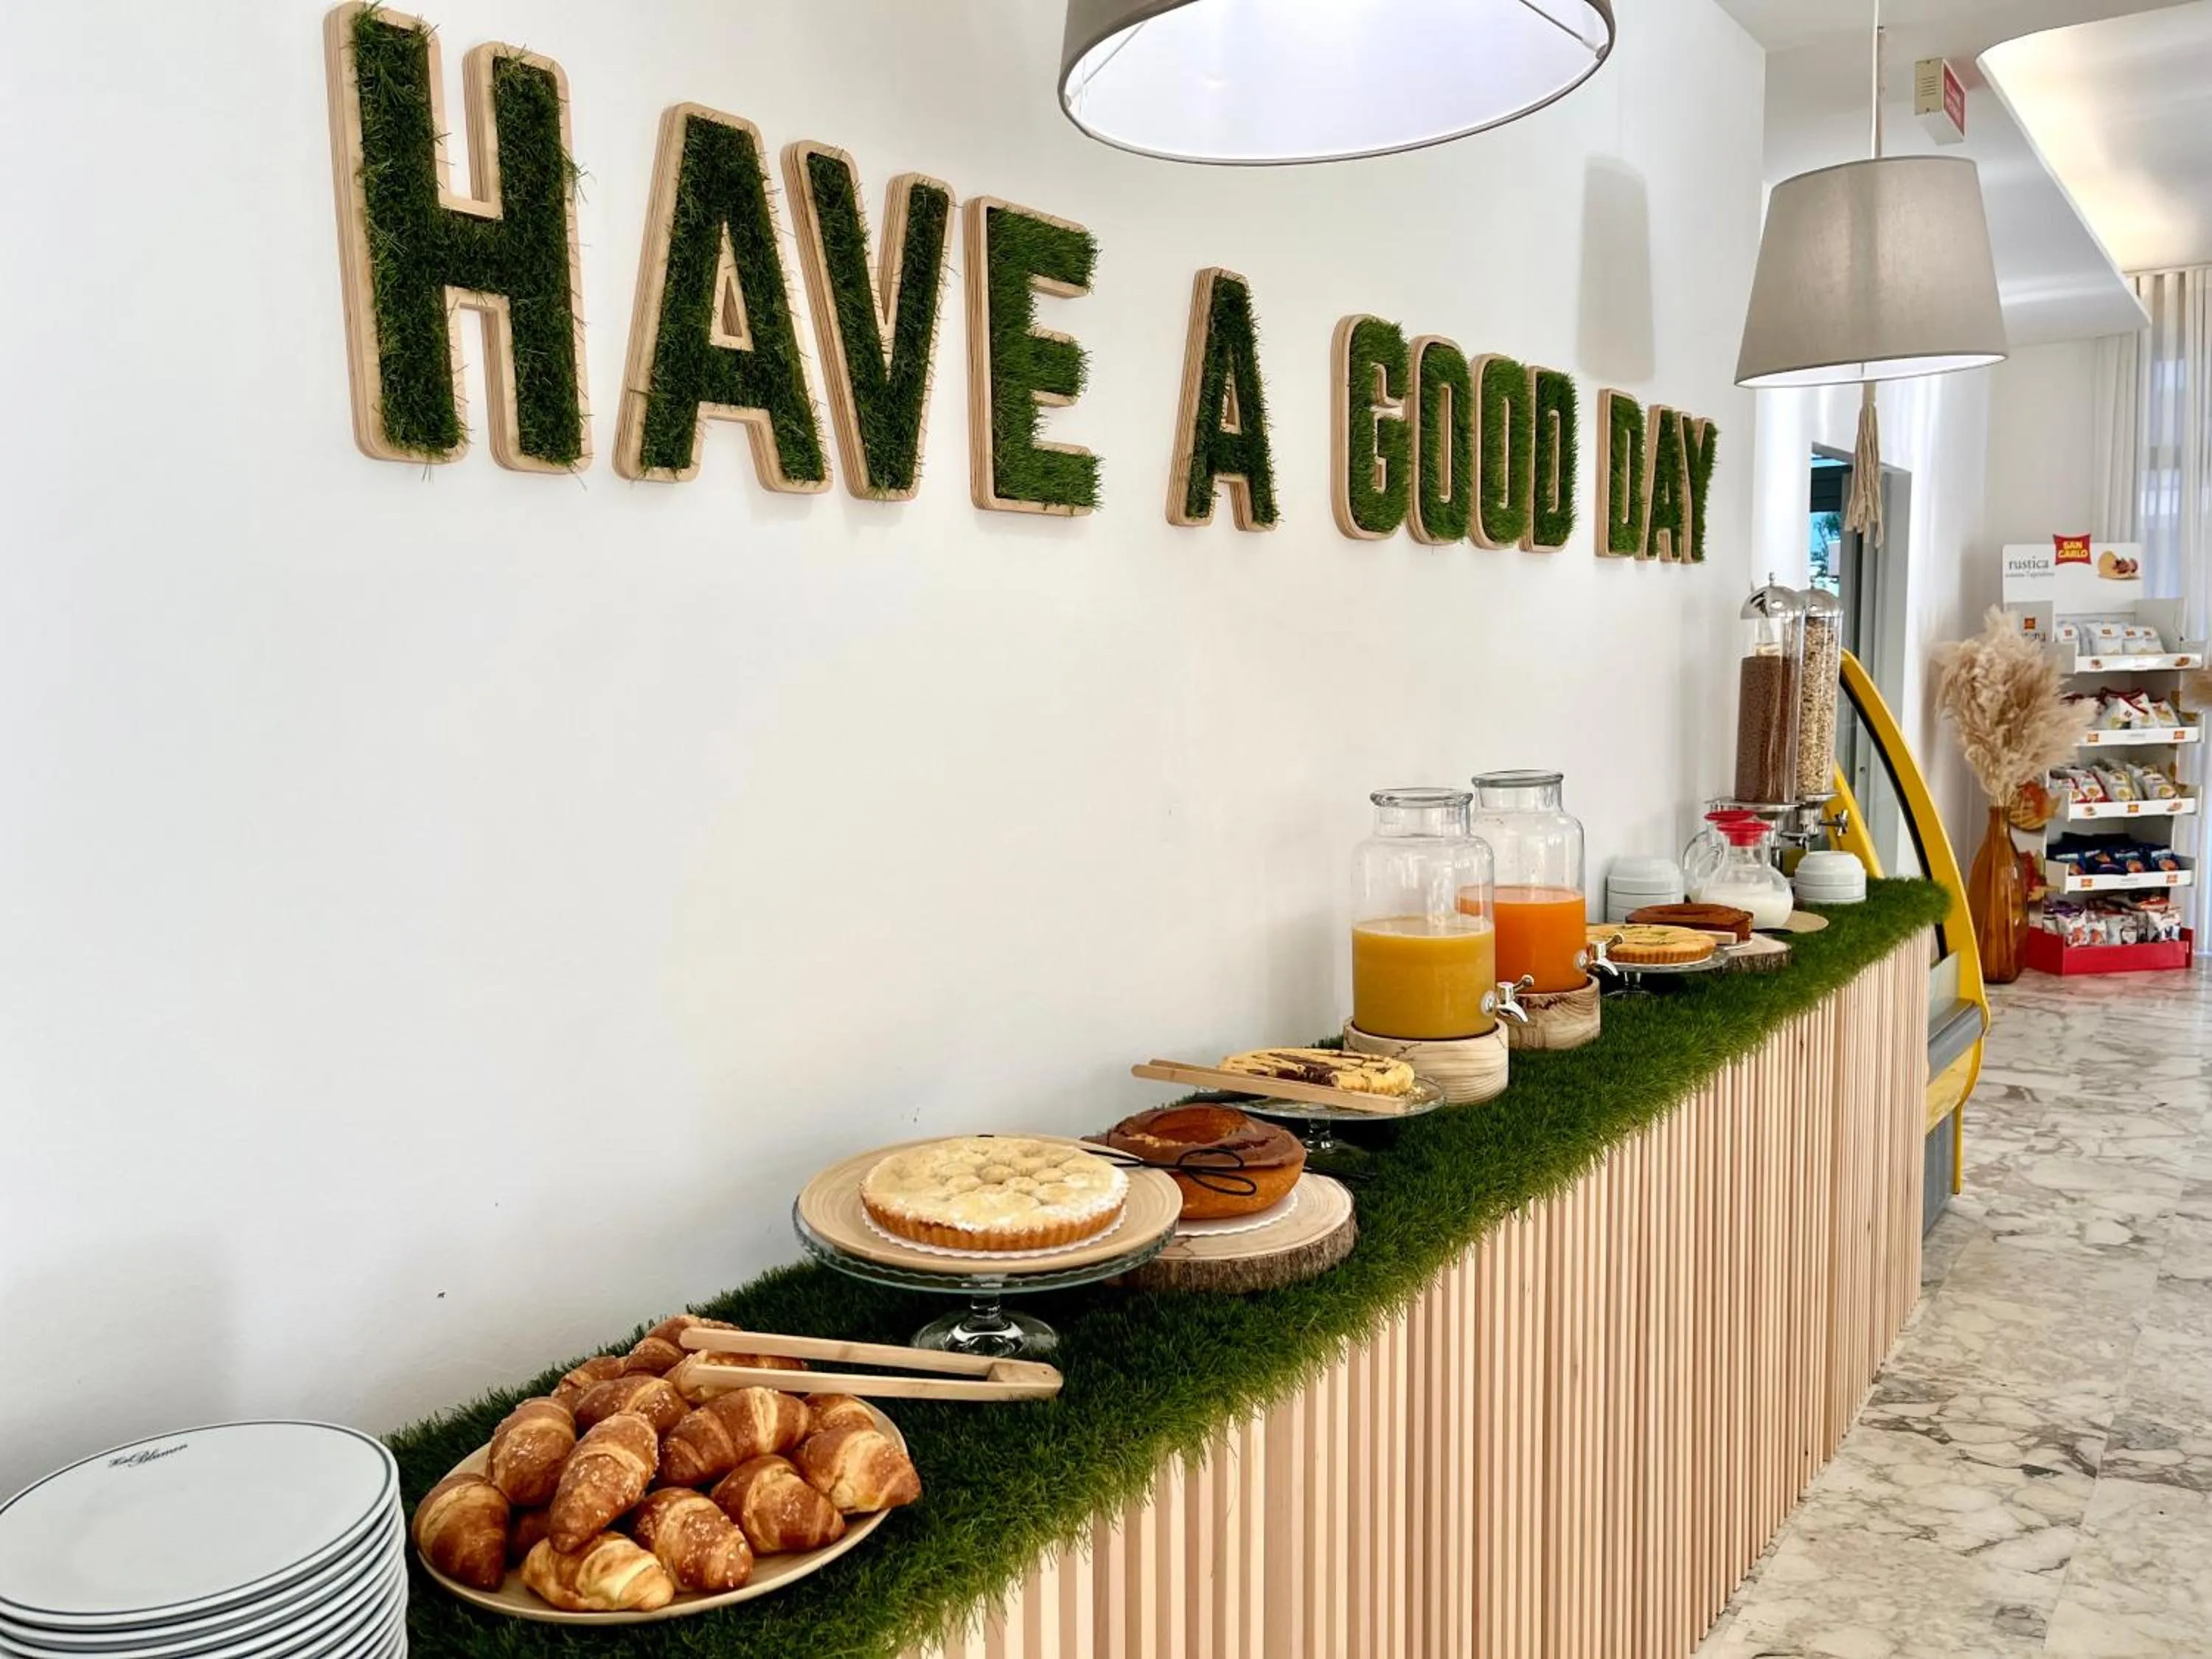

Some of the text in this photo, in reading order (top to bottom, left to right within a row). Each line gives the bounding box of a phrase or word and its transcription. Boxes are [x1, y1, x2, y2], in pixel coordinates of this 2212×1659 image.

[324, 1, 1720, 564] HAVE A GOOD DAY
[2062, 540, 2083, 549] SAN
[2058, 549, 2088, 558] CARLO
[2008, 555, 2049, 570] rustica
